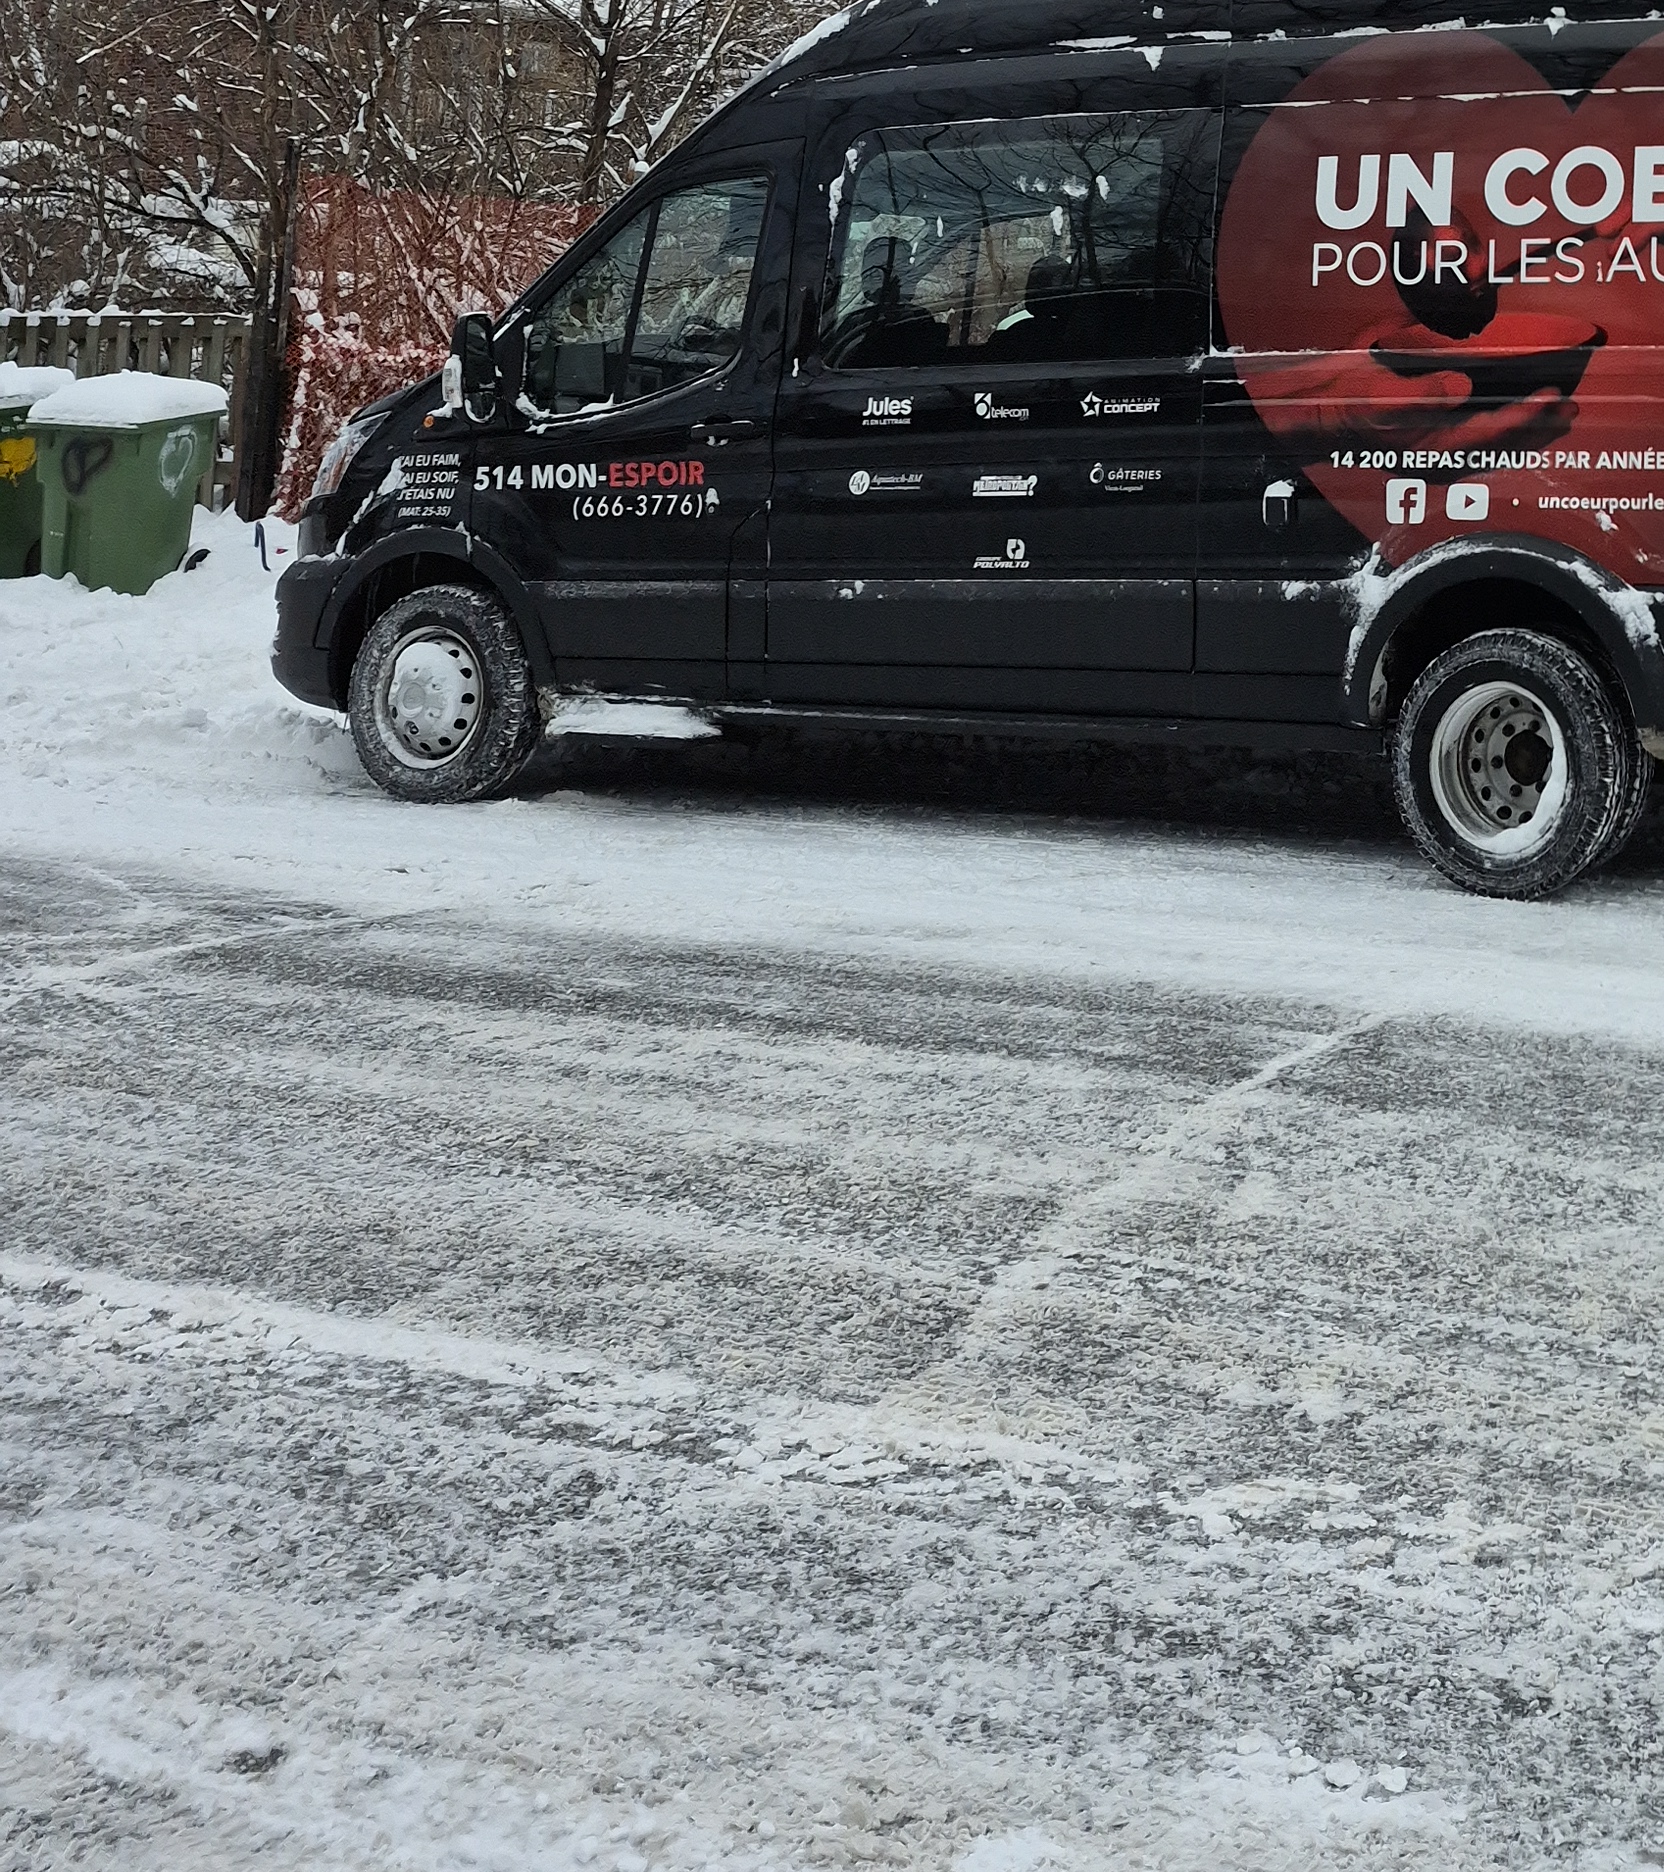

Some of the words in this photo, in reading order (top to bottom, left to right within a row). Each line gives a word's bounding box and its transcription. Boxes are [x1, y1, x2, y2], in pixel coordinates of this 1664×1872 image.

[1314, 151, 1455, 230] UN
[1311, 239, 1469, 287] POUR
[1487, 237, 1585, 284] LES
[863, 396, 914, 417] Jules
[1103, 403, 1161, 414] CONCEPT
[415, 454, 432, 466] EU
[1330, 450, 1354, 469] 14
[1360, 450, 1397, 469] 200
[1402, 450, 1465, 469] REPAS
[1467, 450, 1550, 469] CHAUDS
[1554, 451, 1591, 470] PAR
[415, 471, 432, 484] EU
[431, 470, 460, 484] SOIF,
[473, 465, 524, 491] 514
[531, 460, 705, 490] MON-ESPOIR
[1107, 468, 1162, 481] GÂTERIES
[435, 487, 456, 500] NU
[573, 493, 703, 521] (666-3776)
